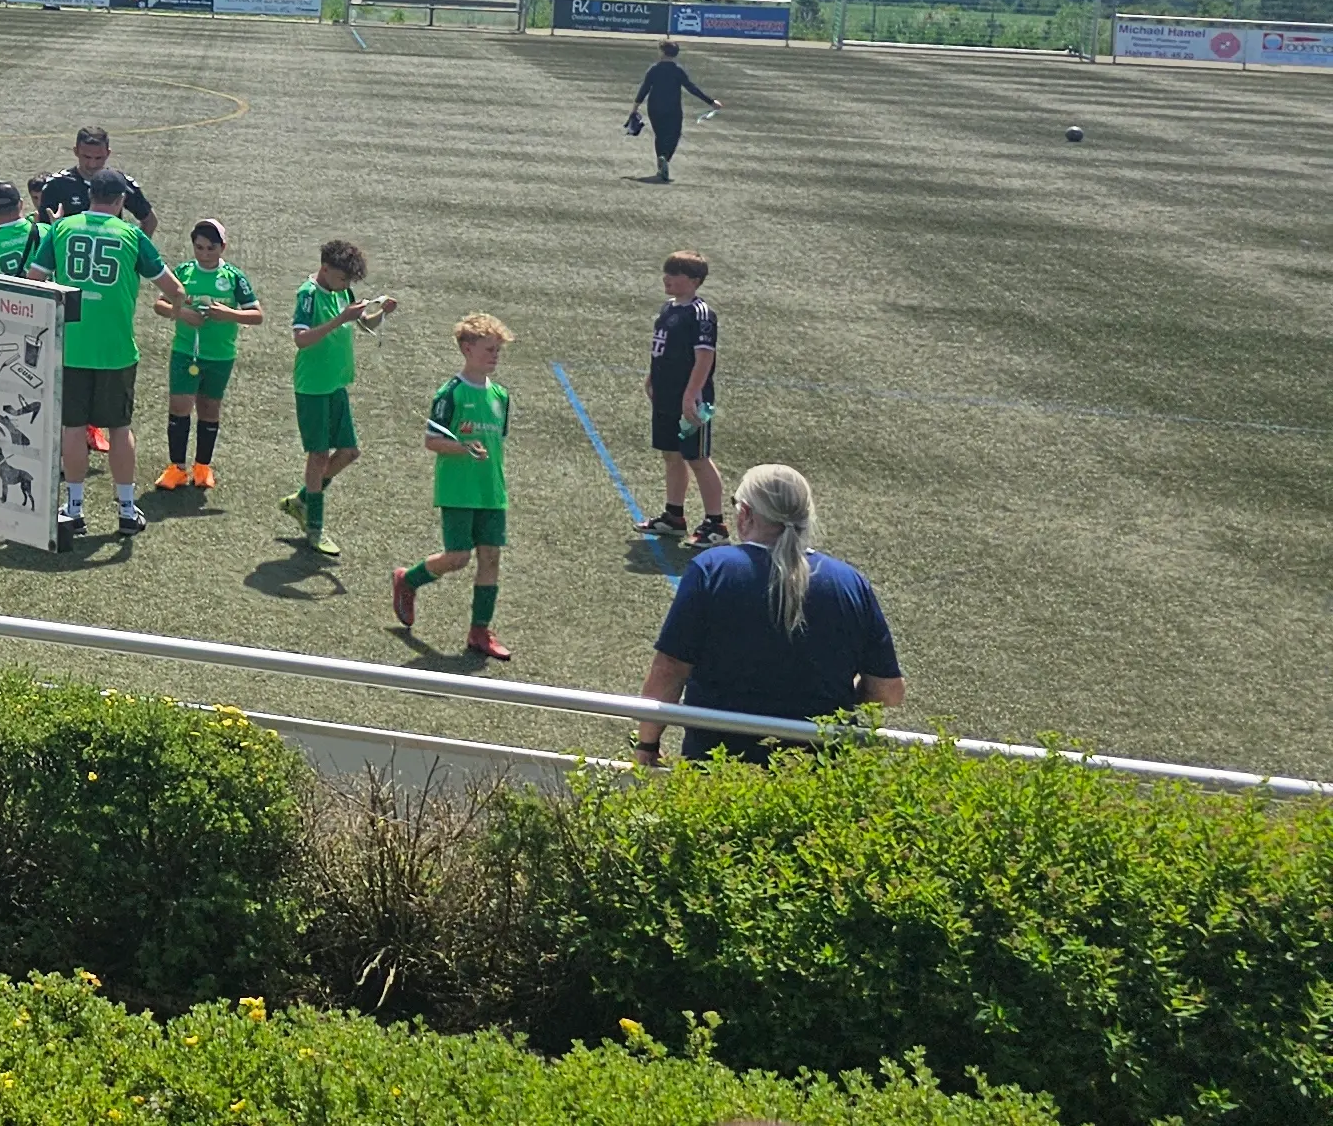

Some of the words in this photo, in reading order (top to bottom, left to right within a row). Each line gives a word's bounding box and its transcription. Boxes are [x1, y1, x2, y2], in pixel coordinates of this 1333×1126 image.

[601, 2, 651, 14] DIGITAL
[1118, 24, 1165, 36] Michael
[1168, 27, 1206, 39] Hamel
[66, 233, 123, 286] 85
[0, 298, 34, 319] Nein!
